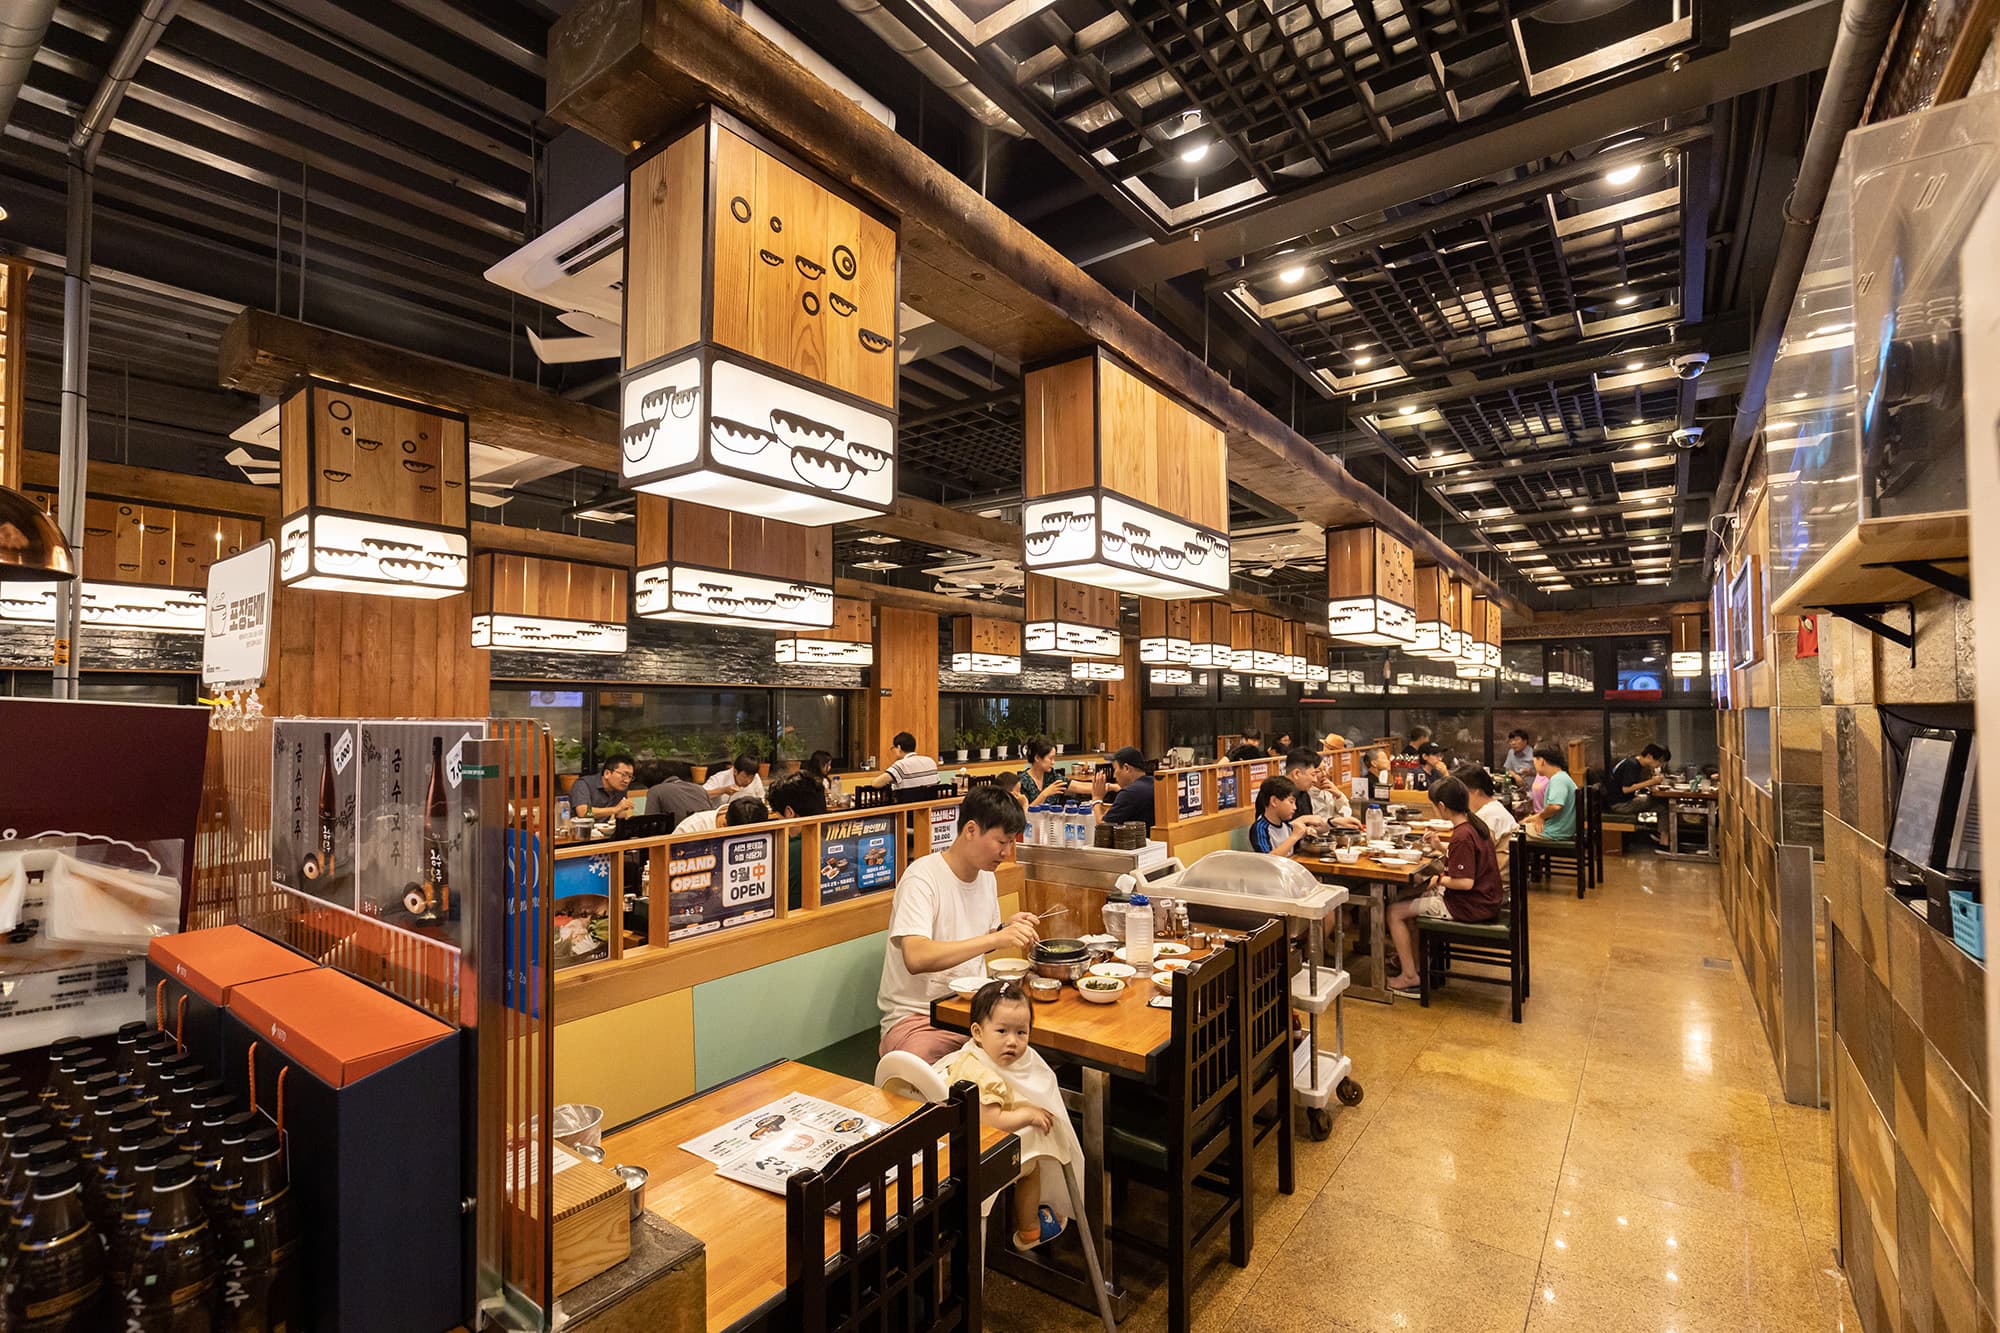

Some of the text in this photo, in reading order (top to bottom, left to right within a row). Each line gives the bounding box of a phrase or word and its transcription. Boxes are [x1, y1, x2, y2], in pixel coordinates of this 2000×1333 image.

[229, 592, 265, 631] 포장판매
[391, 749, 402, 866] 금수모주
[669, 855, 717, 876] GRAND
[730, 863, 766, 883] 9월 中
[671, 872, 712, 893] OPEN
[731, 882, 765, 900] OPEN
